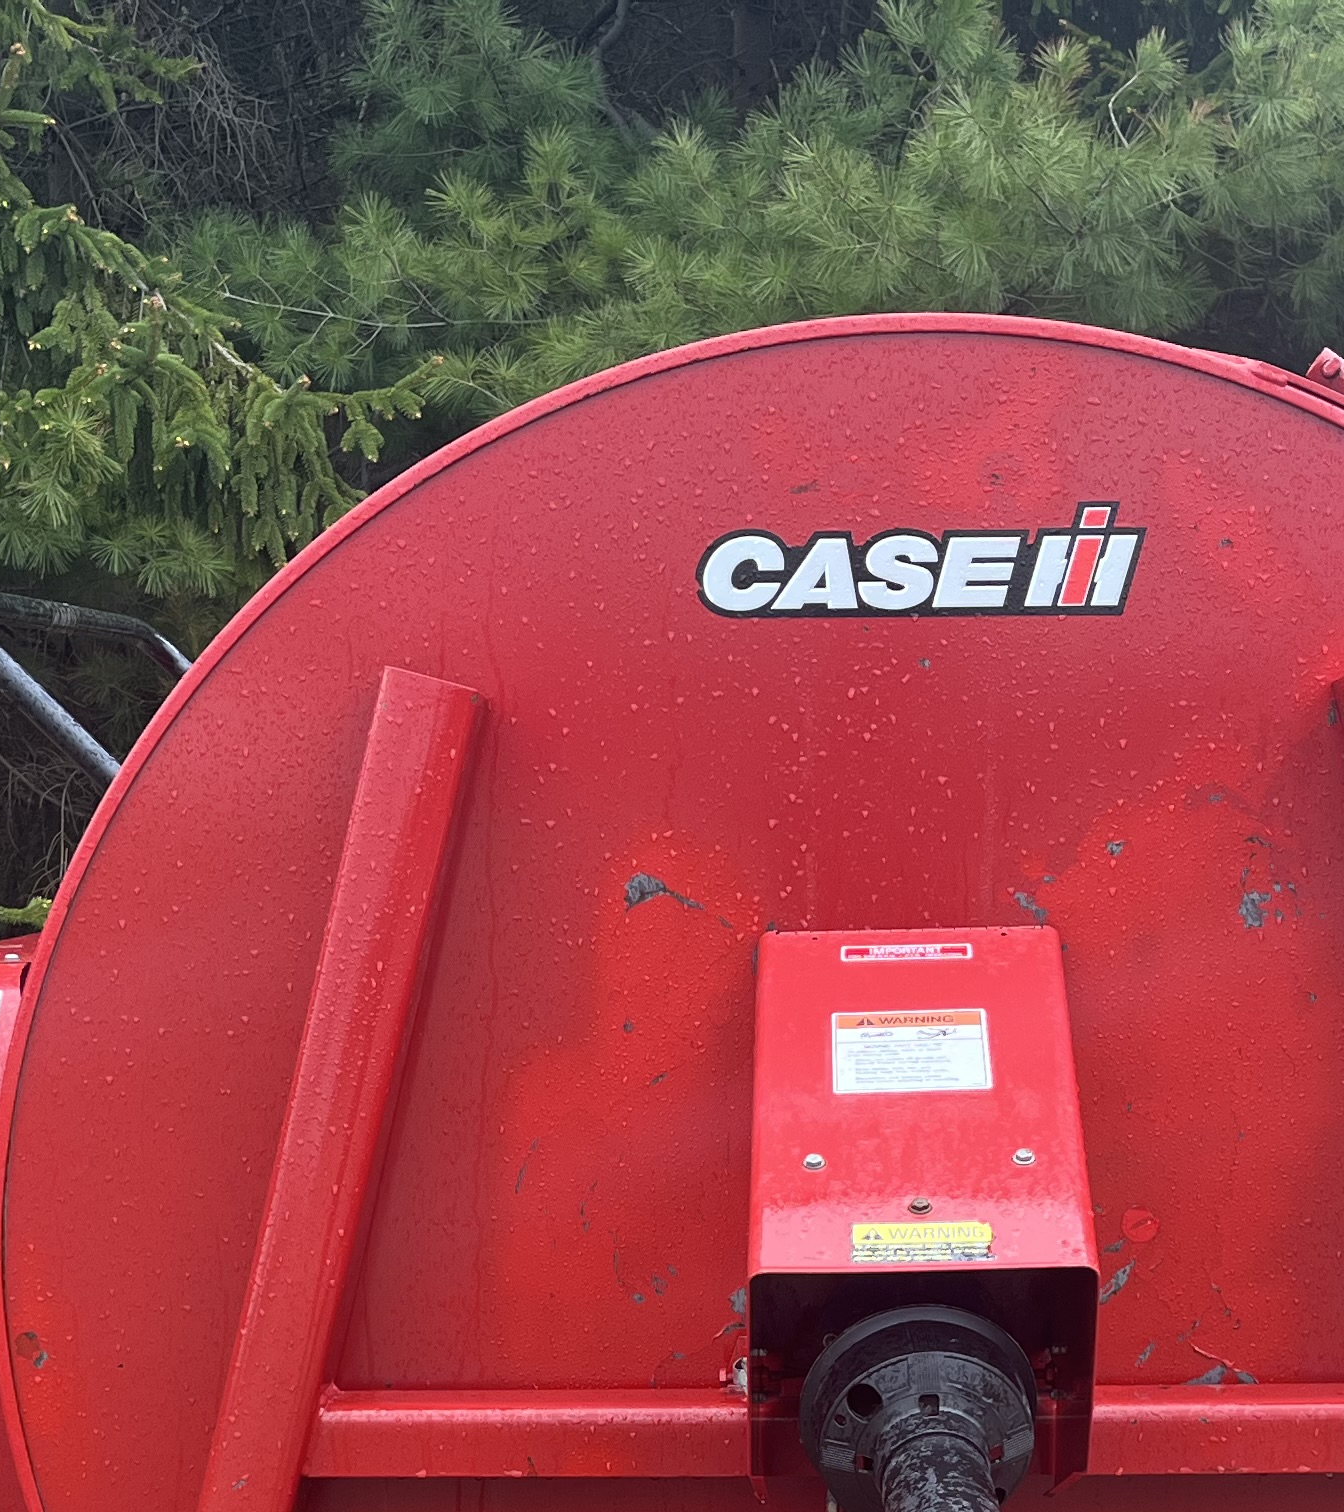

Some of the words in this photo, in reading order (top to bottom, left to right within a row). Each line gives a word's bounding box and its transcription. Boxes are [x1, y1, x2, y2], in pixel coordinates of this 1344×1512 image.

[702, 534, 1022, 611] CASE
[869, 946, 942, 955] IMPORTANT
[878, 1015, 954, 1025] WARNING
[888, 1226, 984, 1239] WARNING
